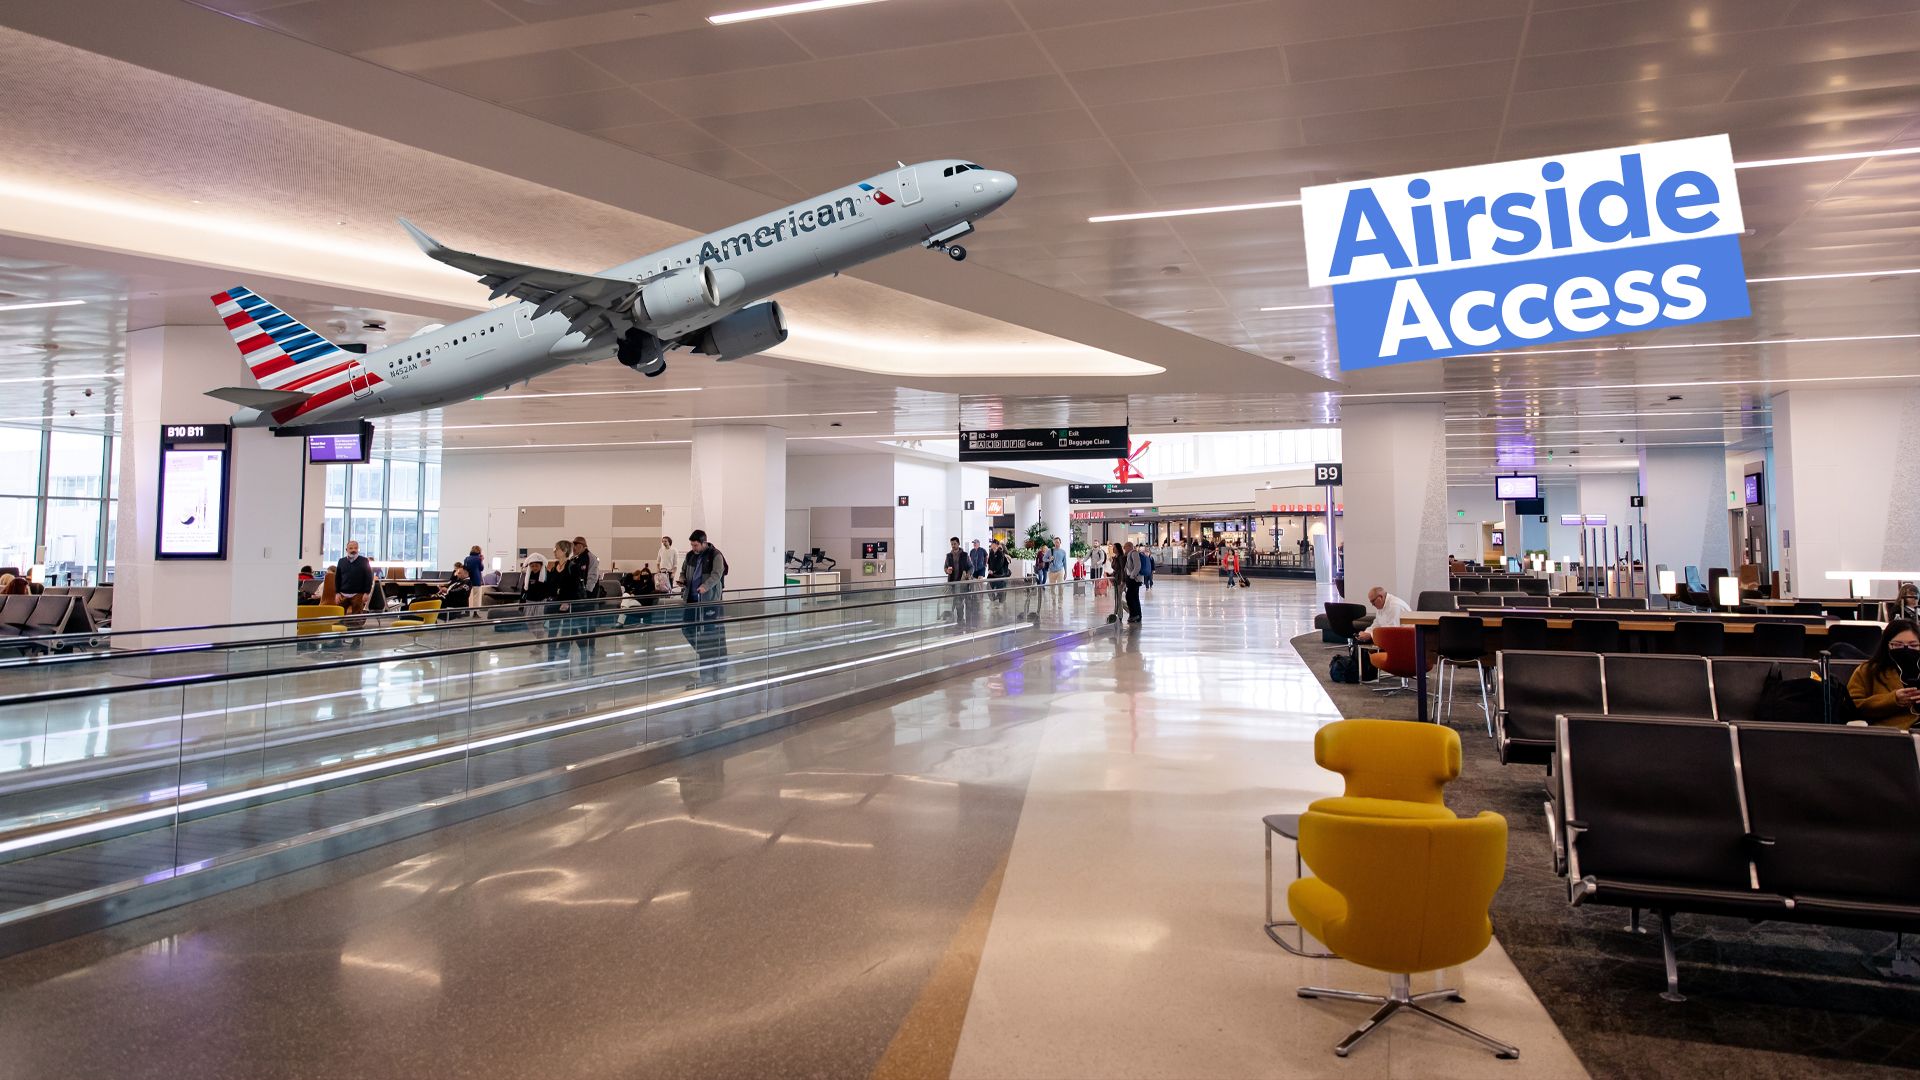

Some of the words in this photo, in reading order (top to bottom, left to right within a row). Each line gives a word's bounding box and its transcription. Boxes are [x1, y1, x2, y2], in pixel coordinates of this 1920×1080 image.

[698, 196, 857, 266] American
[390, 363, 418, 378] N452AN
[167, 426, 186, 438] B10
[187, 426, 204, 437] B11
[1068, 439, 1093, 447] Baggage
[1317, 467, 1338, 480] B9
[988, 501, 1001, 514] illy
